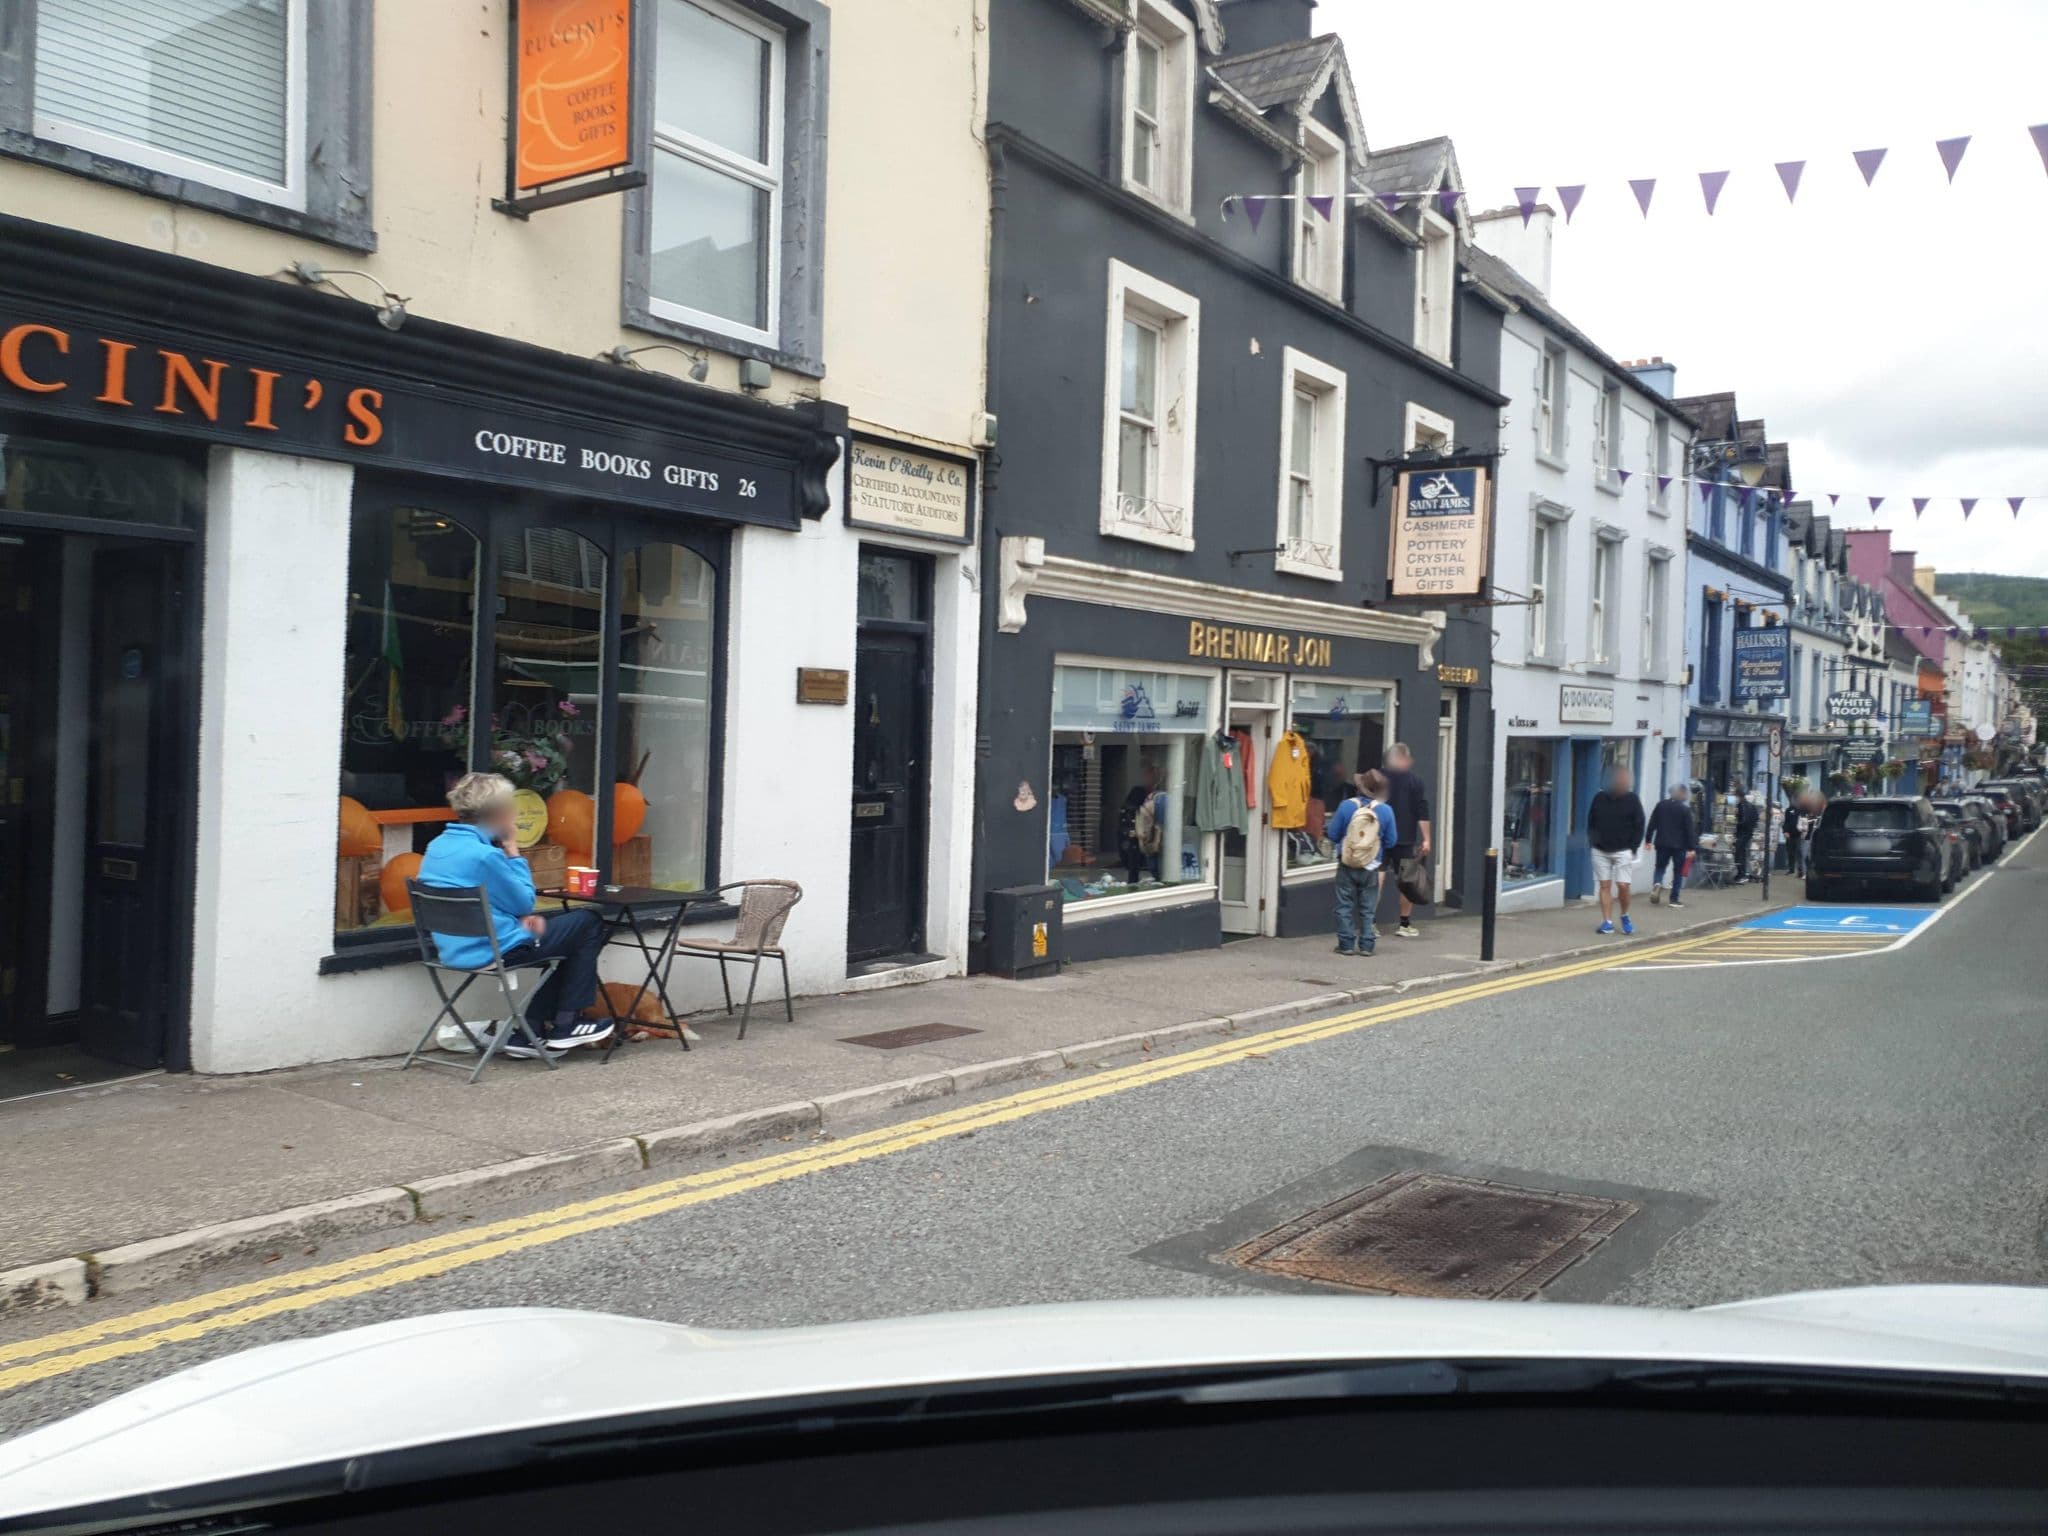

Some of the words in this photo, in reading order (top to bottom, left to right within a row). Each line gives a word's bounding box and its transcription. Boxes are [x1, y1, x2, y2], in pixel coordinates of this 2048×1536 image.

[524, 11, 625, 57] PUCCINI'S
[566, 81, 617, 107] COFFEE
[573, 104, 617, 125] BOOKS
[578, 122, 617, 143] GIFTS
[0, 323, 384, 446] CINI'S
[474, 430, 567, 465] COFFEE
[580, 449, 651, 479] BOOKS
[662, 465, 719, 492] GIFTS
[738, 478, 757, 498] 26
[852, 448, 886, 471] Kevin
[889, 456, 934, 485] O'Reilly
[936, 468, 945, 483] &
[853, 474, 900, 495] CERTIFIED
[902, 485, 961, 506] ACCOUNTANTS
[861, 492, 915, 513] STATUTORY
[916, 505, 959, 522] AUDITORS
[1410, 498, 1439, 511] SAINT
[1439, 497, 1471, 510] JAMES
[1403, 520, 1476, 532] CASHMERE
[1407, 539, 1468, 551] POTTERY
[1407, 553, 1465, 564] CRYSTAL
[1406, 567, 1466, 578] LEATHER
[1416, 580, 1454, 590] GIFTS
[1189, 620, 1289, 665] BRENMAR
[1294, 638, 1331, 668] JON
[1829, 698, 1873, 708] WHITE
[1841, 691, 1861, 699] THE
[1831, 707, 1871, 716] ROOM
